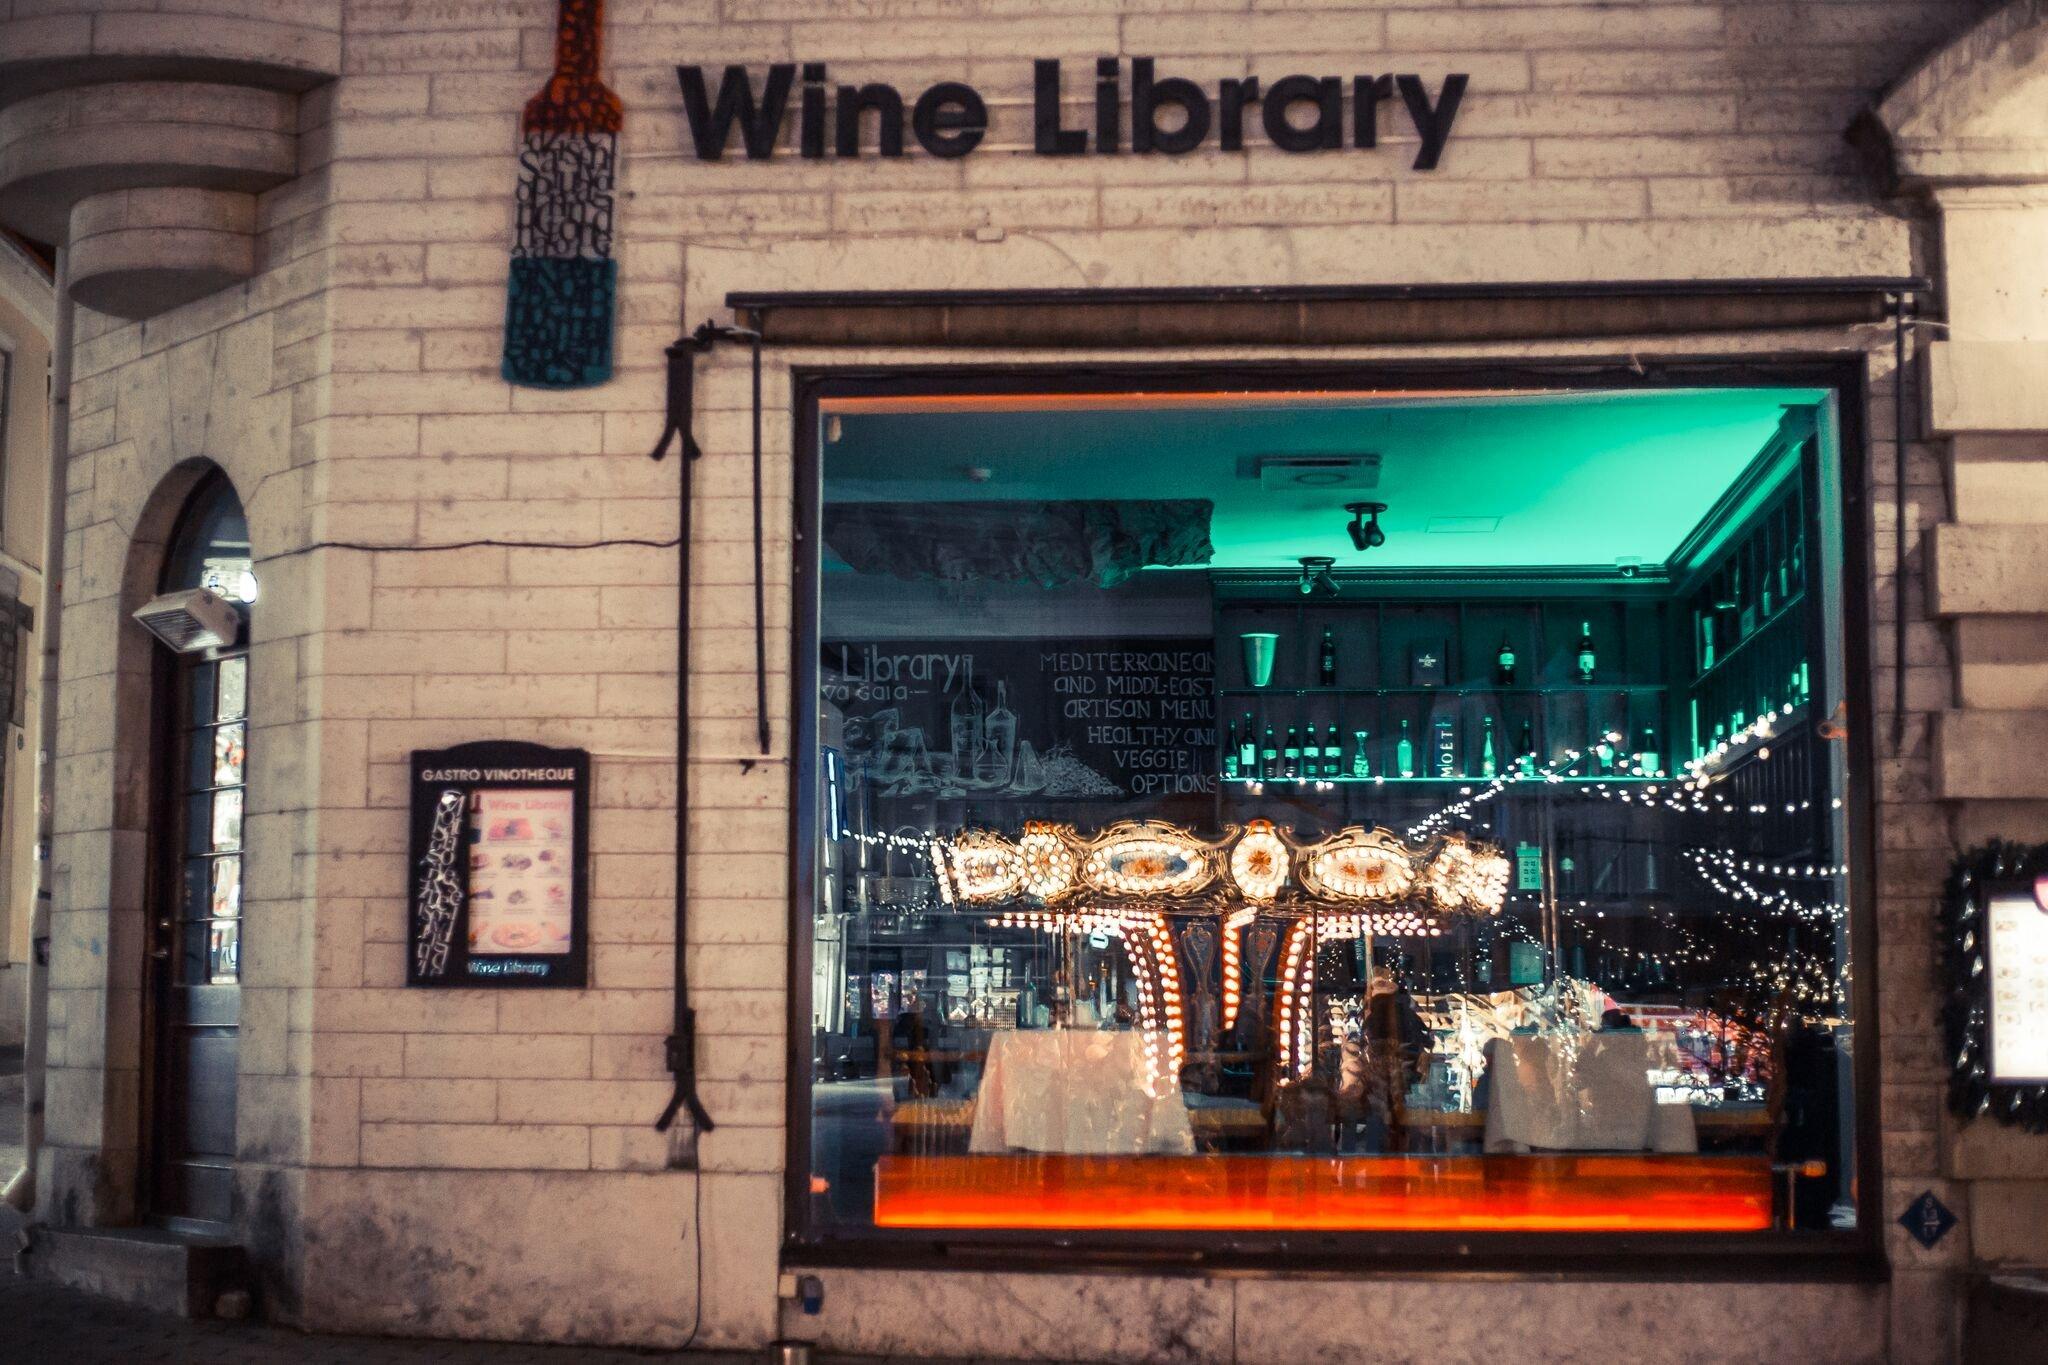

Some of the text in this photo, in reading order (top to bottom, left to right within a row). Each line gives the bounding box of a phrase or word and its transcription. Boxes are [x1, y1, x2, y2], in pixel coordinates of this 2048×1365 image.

[675, 57, 1470, 170] Wine Library
[842, 644, 960, 693] Library
[1161, 700, 1216, 719] MENU
[1113, 750, 1188, 768] VEGGIE
[422, 768, 575, 781] GASTRO VINOTHEQUE
[1131, 774, 1216, 793] OPTIONS
[467, 960, 549, 976] Wine Library
